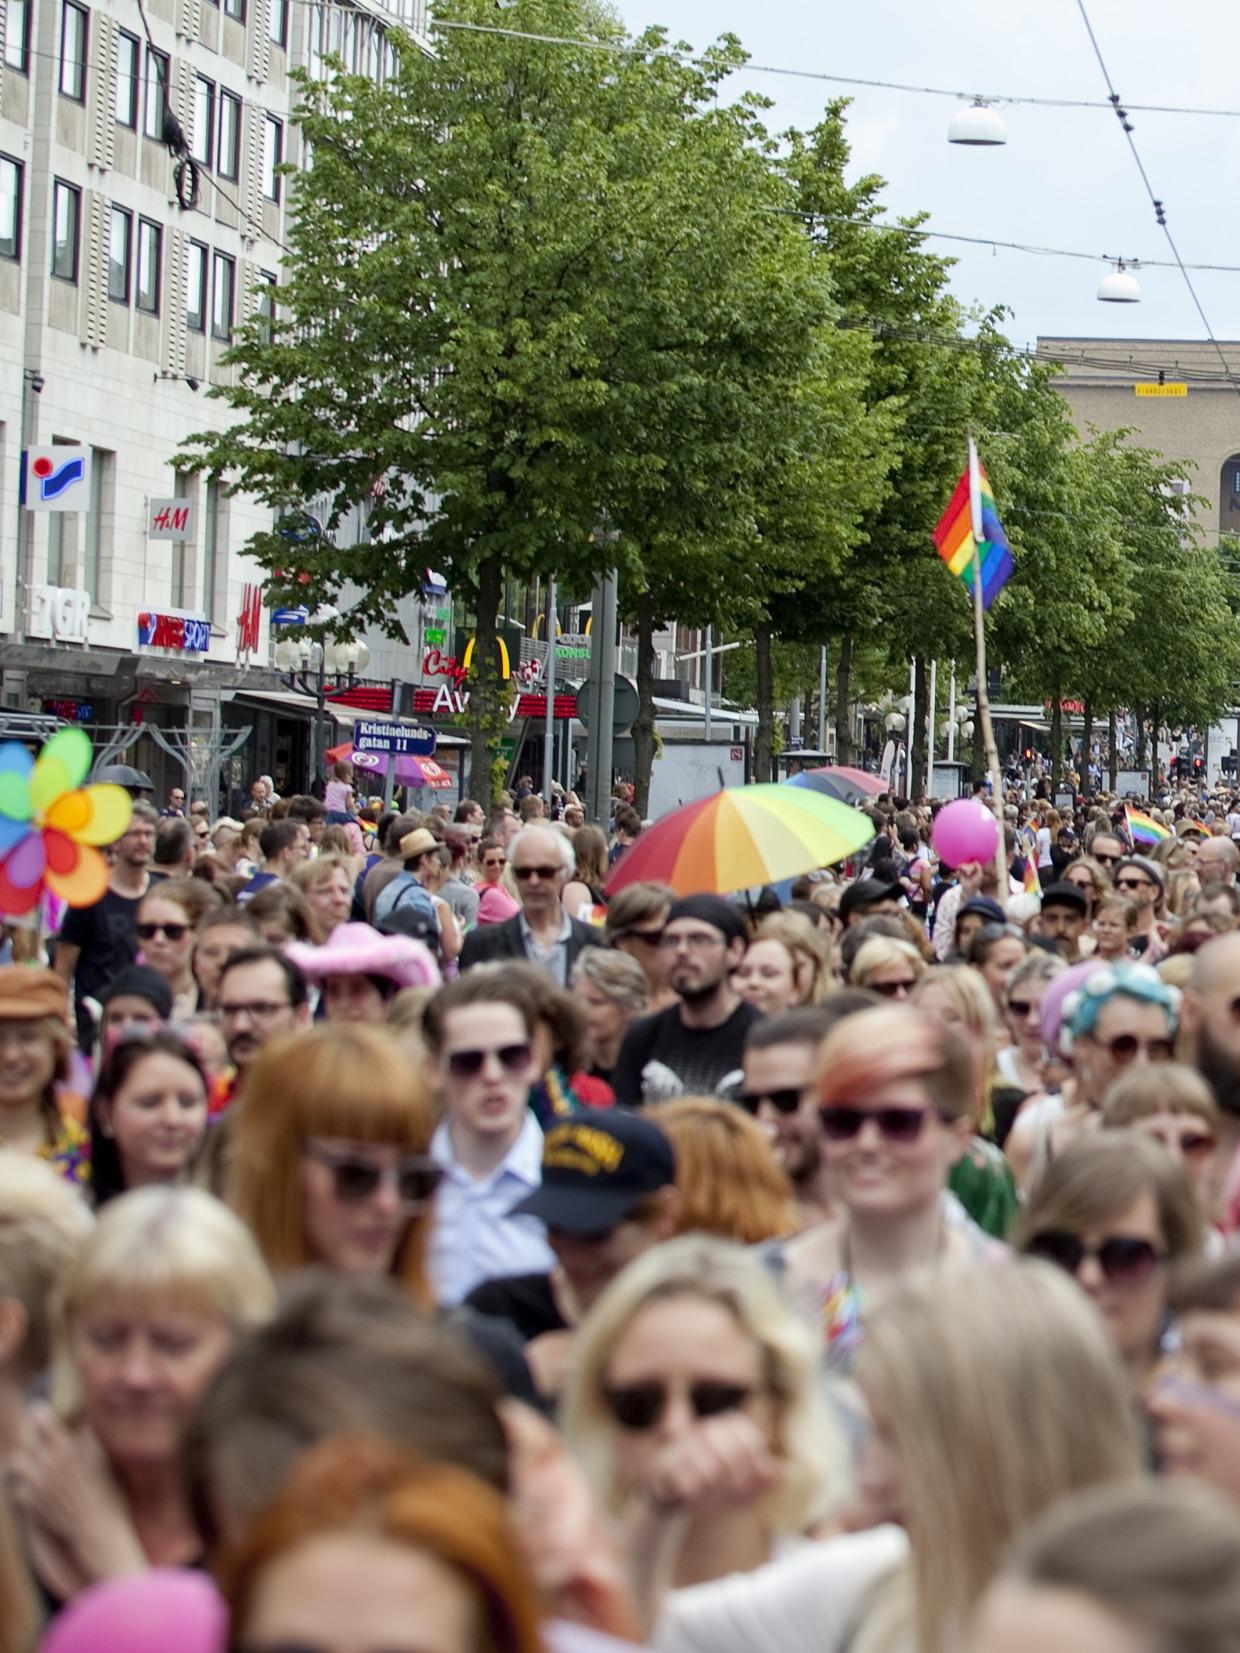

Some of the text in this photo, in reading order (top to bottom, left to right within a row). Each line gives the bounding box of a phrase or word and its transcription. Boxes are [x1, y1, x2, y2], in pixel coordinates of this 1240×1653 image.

[153, 506, 189, 531] H&M
[360, 722, 432, 740] Kristinelunds-
[359, 737, 408, 751] gatan 11
